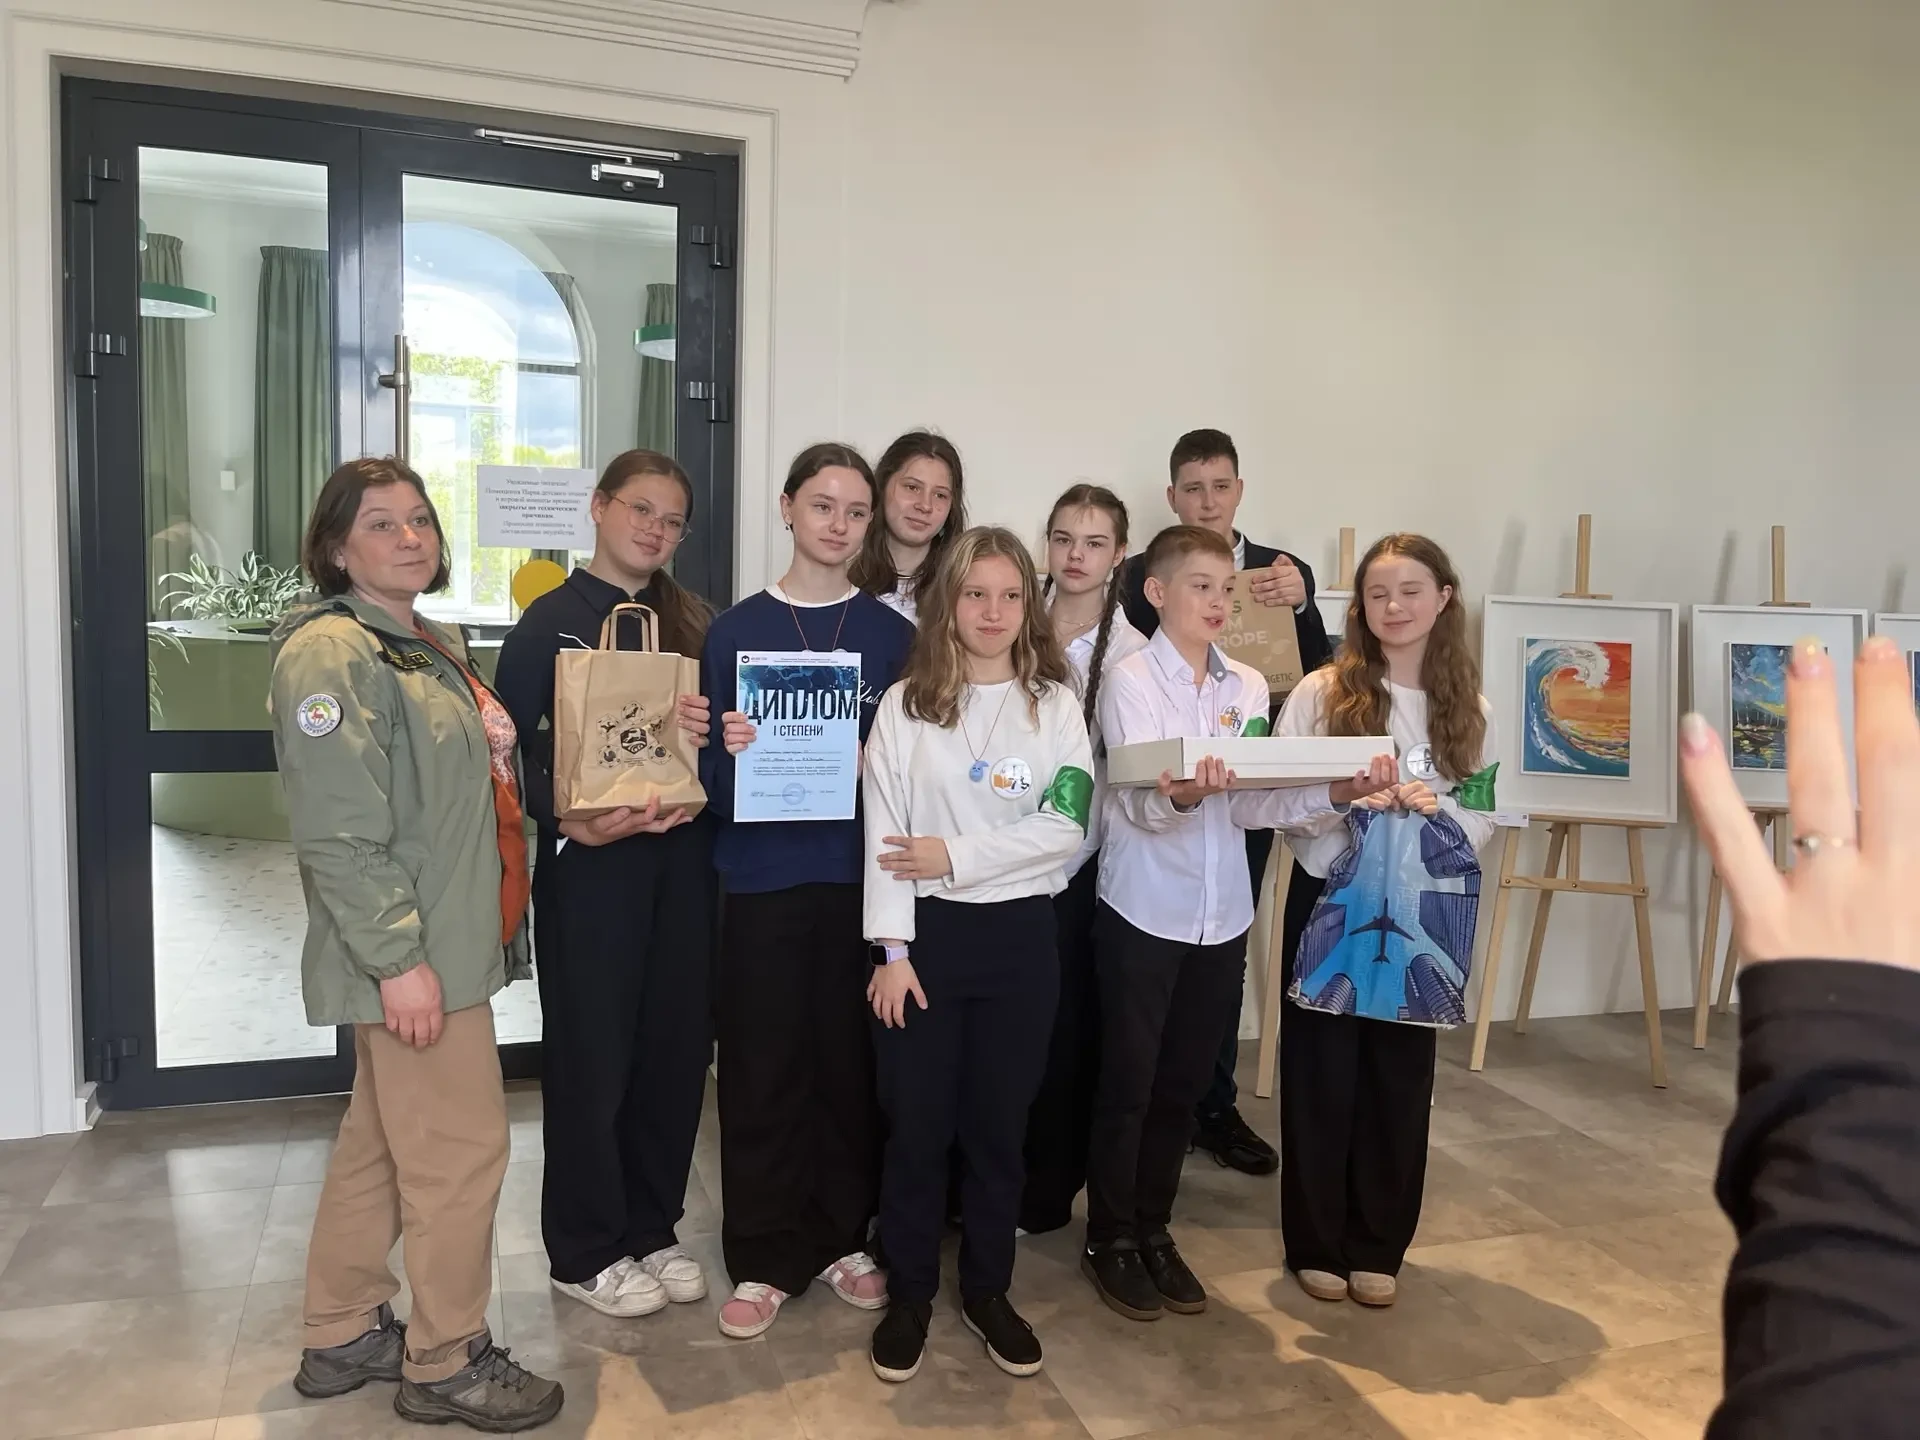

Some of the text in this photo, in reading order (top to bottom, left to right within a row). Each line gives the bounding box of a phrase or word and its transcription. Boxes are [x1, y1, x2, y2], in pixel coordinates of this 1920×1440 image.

[1219, 630, 1268, 648] ROPE
[744, 687, 857, 725] ДИПЛОМ
[779, 723, 824, 738] СТЕПЕНИ
